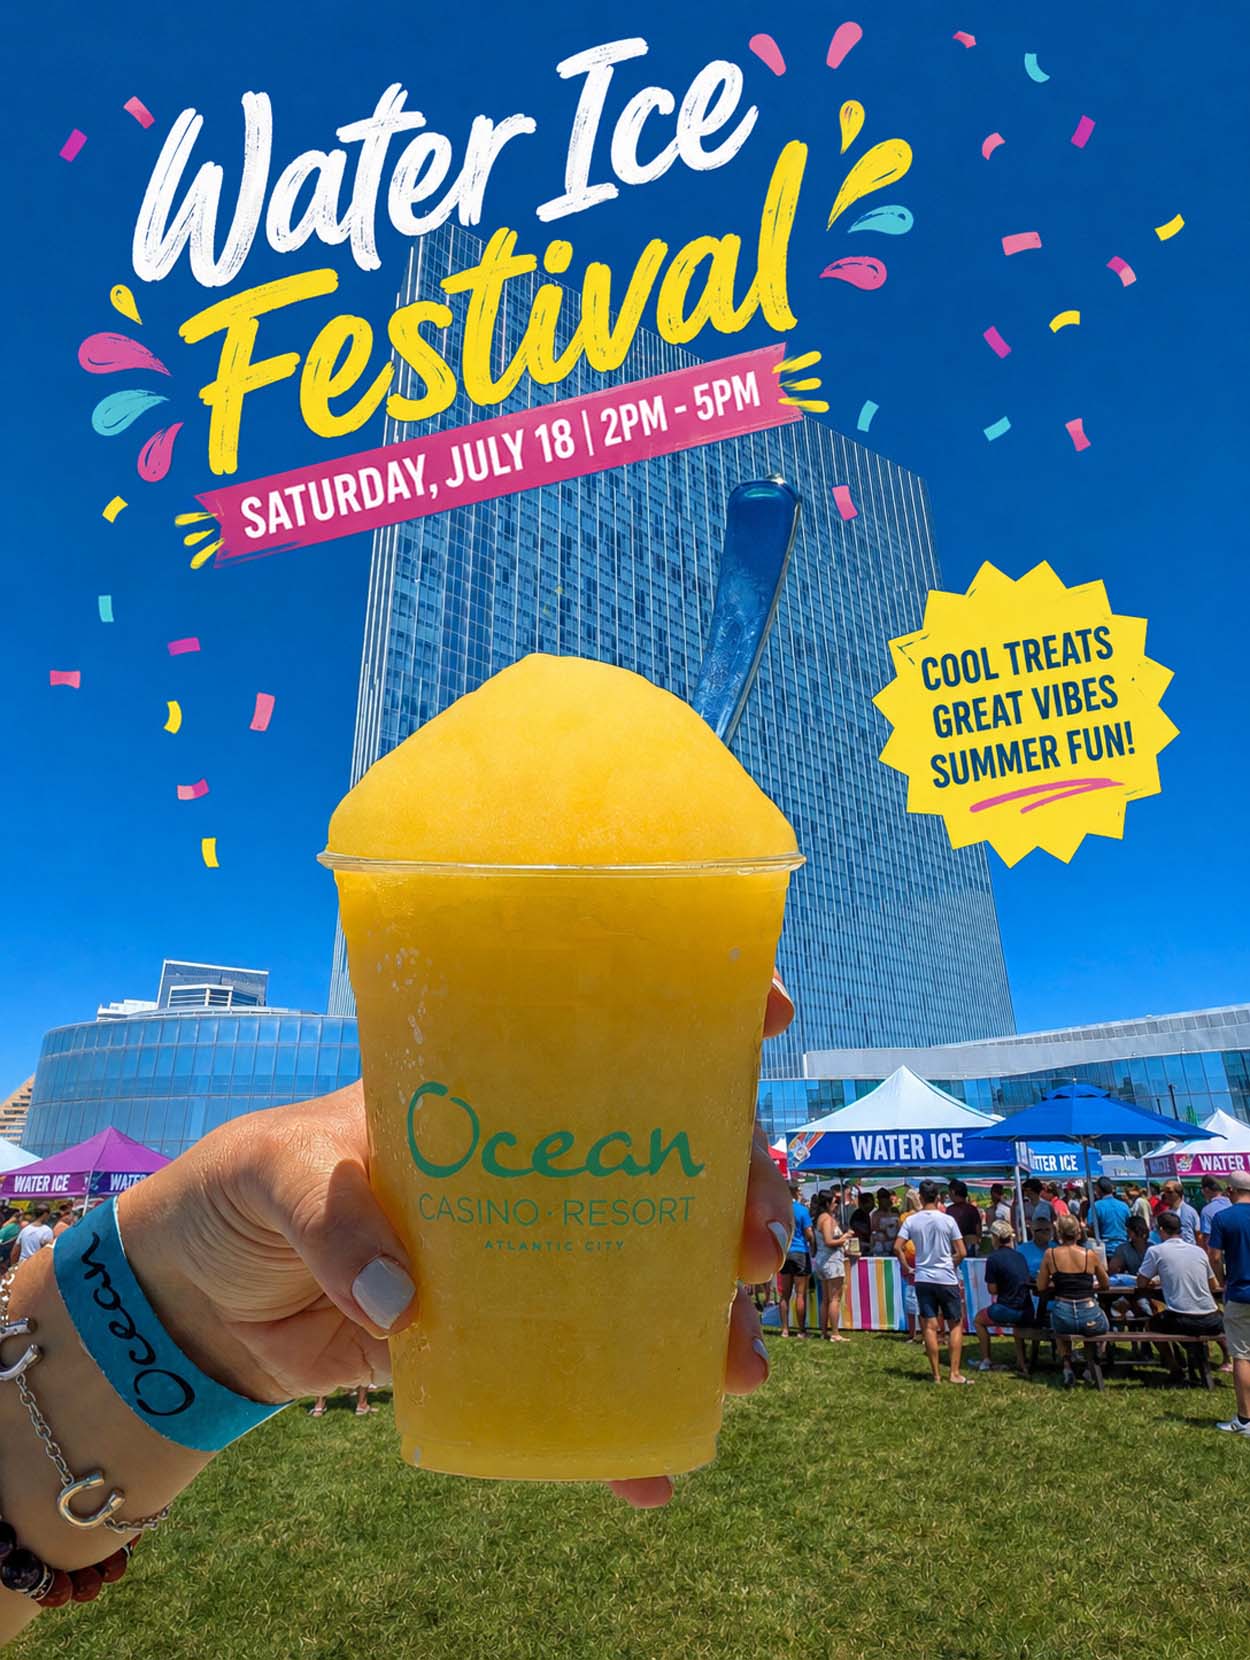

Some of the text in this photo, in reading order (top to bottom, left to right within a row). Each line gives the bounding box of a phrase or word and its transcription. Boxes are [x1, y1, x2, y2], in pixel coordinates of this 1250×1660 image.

[406, 1081, 705, 1179] Ocean
[851, 1132, 965, 1161] WATER ICE
[1059, 1154, 1079, 1172] ICE
[1198, 1155, 1245, 1171] WATER
[14, 1174, 71, 1193] WATER ICE
[419, 1192, 540, 1227] CASINO
[563, 1196, 697, 1227] RESORT
[484, 1239, 625, 1251] ATLANTIC CITY
